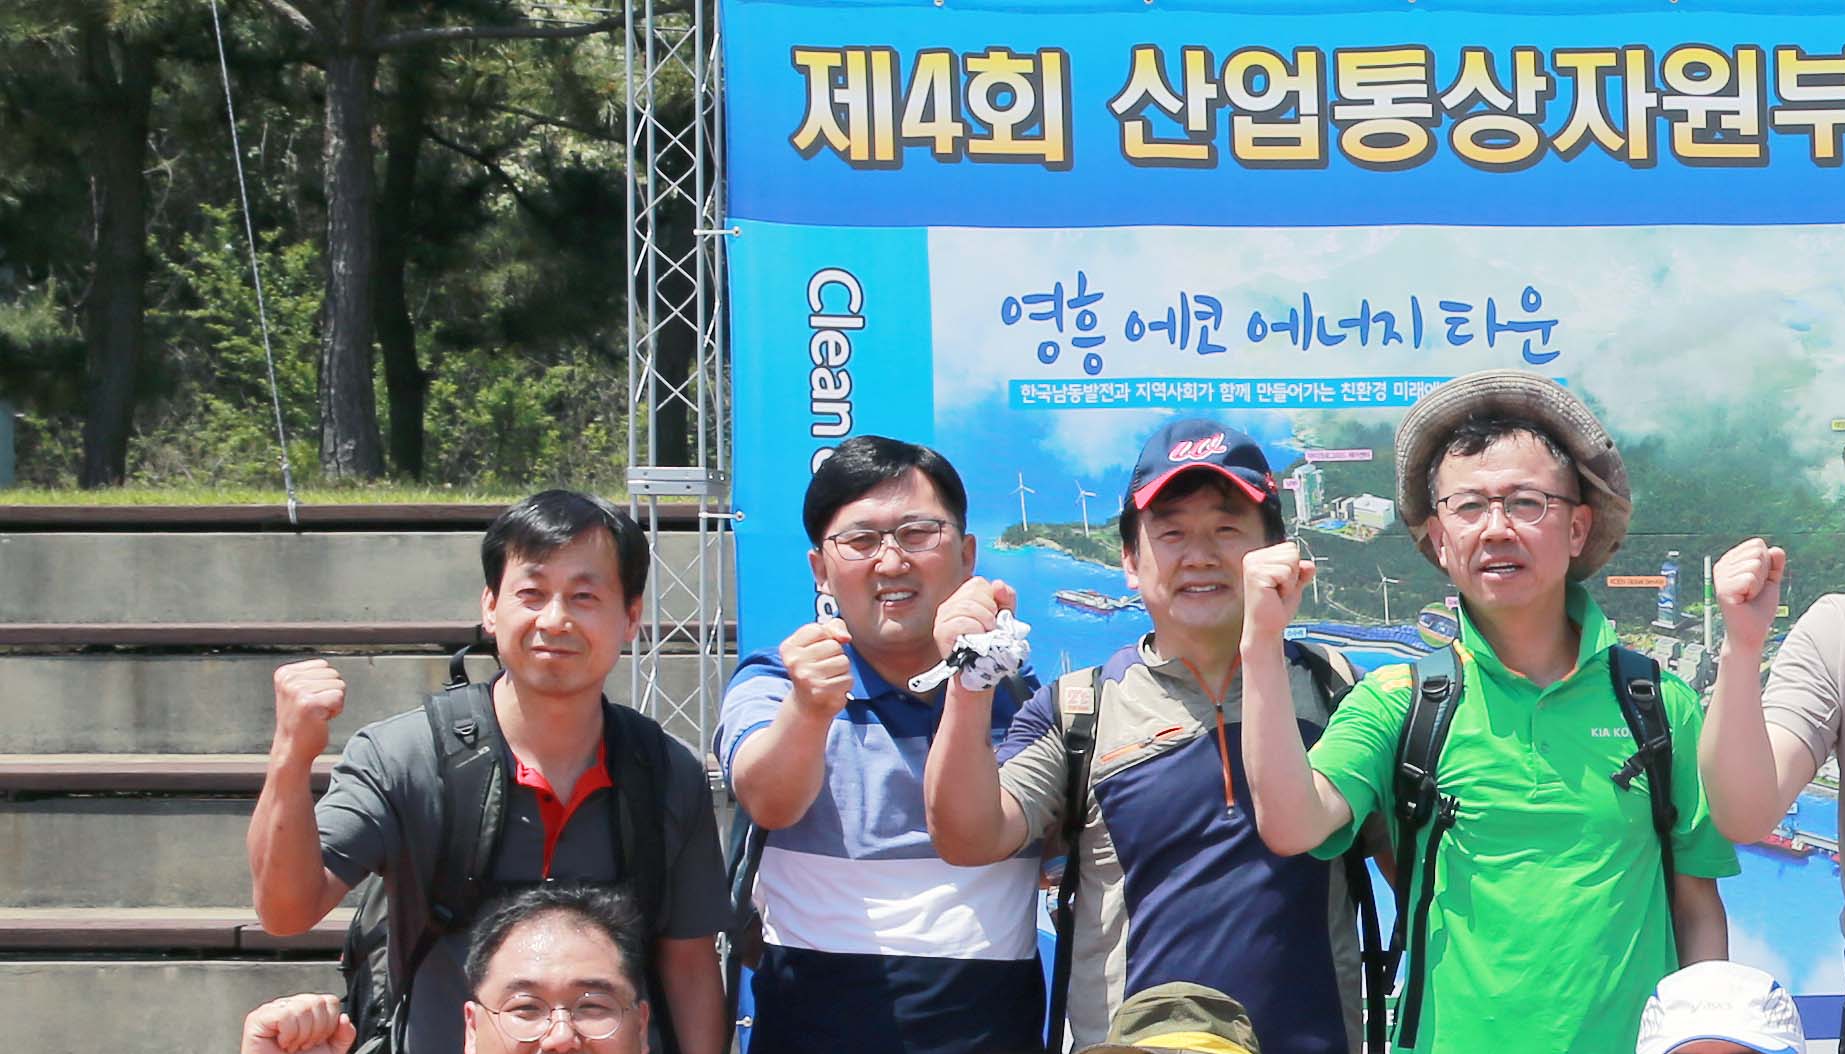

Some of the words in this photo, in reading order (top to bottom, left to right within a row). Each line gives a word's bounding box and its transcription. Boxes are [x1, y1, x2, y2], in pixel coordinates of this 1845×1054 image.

[793, 45, 1075, 171] 제4회
[807, 267, 865, 438] Clean
[1001, 270, 1105, 375] 영흥
[1124, 291, 1227, 355] 에코
[1247, 291, 1423, 350] 에너지
[1439, 286, 1561, 364] 타운
[1020, 381, 1130, 403] 한국남동발전과
[1135, 380, 1213, 402] 지역사회가
[1219, 380, 1251, 402] 함께
[1256, 380, 1336, 402] 만들어가는
[1341, 380, 1387, 402] 친환경
[1591, 728, 1610, 737] KIA
[1613, 728, 1633, 737] KO
